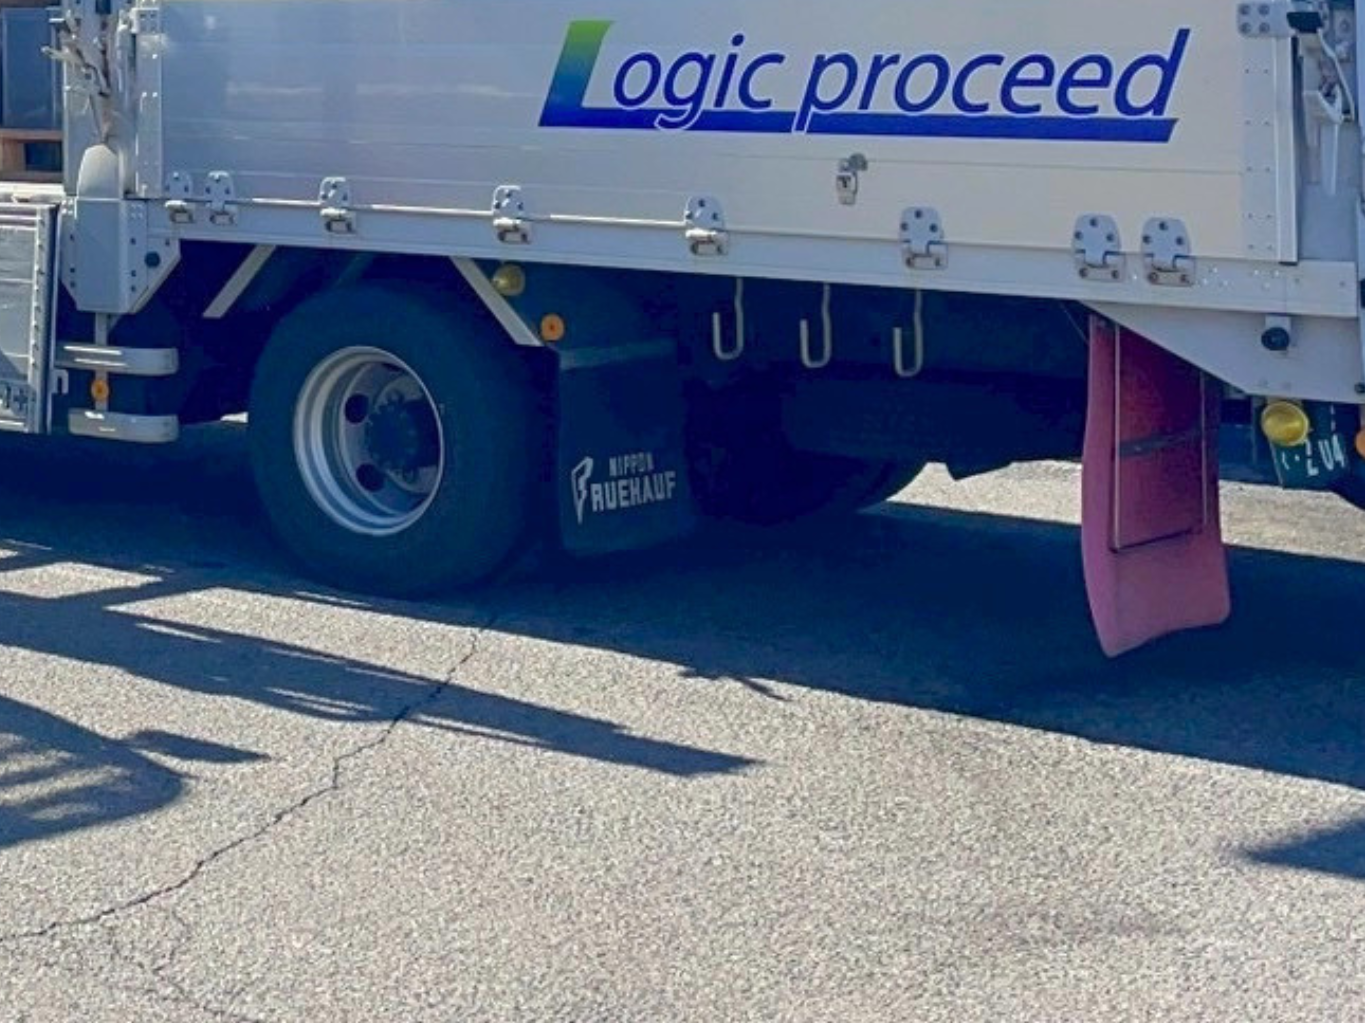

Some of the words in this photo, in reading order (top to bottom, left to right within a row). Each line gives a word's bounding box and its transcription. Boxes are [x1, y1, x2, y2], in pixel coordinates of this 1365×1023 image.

[539, 20, 786, 130] Logic
[791, 28, 1192, 134] proceed
[609, 452, 654, 477] NIPPON
